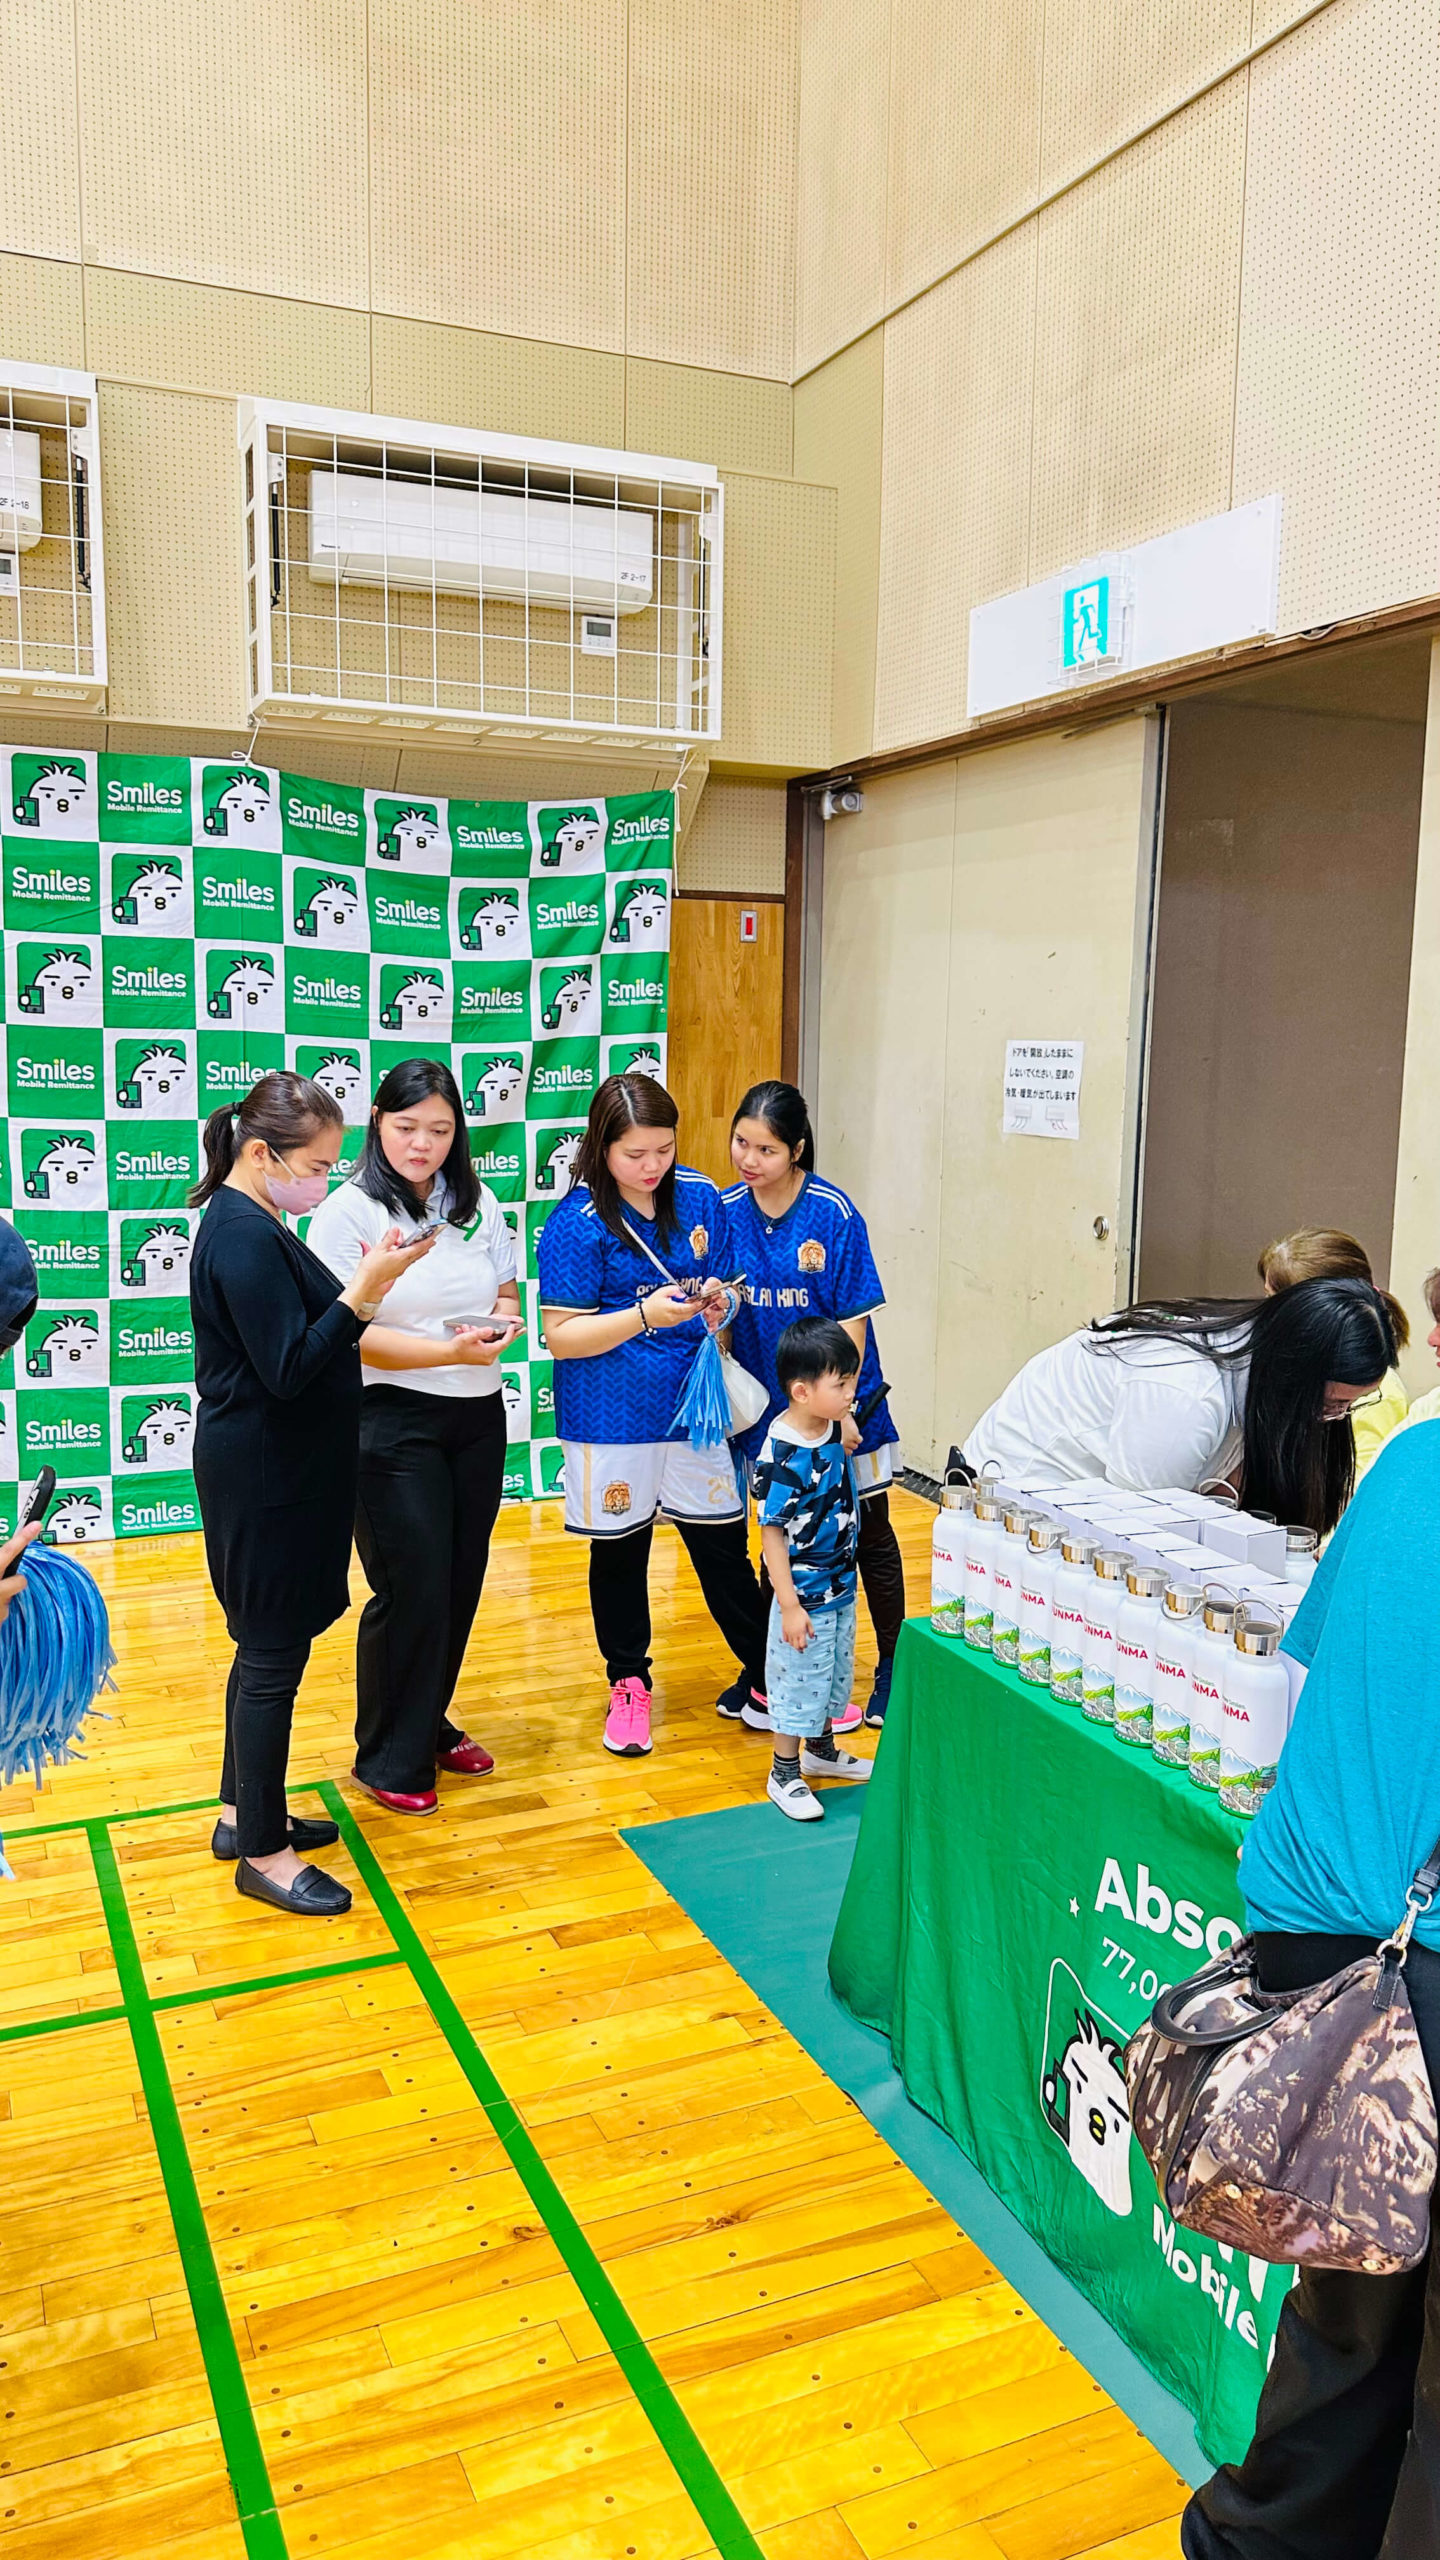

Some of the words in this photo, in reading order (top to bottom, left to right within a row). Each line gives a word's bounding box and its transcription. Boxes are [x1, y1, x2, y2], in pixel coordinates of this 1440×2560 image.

[108, 780, 182, 805] Smiles
[107, 803, 134, 812] Mobile
[137, 805, 182, 814] Remittance
[288, 798, 358, 828] Smiles
[288, 819, 312, 830] Mobile
[314, 822, 358, 836] Remittance
[457, 826, 523, 844] Smiles
[613, 816, 669, 835] Smiles
[12, 867, 90, 893] Smiles
[203, 877, 274, 902] Smiles
[12, 891, 41, 899] Mobile
[44, 893, 90, 902] Remittance
[203, 900, 230, 908] Mobile
[232, 901, 274, 911] Remittance
[375, 897, 440, 922] Smiles
[537, 902, 598, 922] Smiles
[376, 918, 399, 926] Mobile
[401, 920, 441, 930] Remittance
[538, 921, 561, 930] Mobile
[563, 920, 599, 928] Remittance
[112, 966, 186, 988] Smiles
[293, 976, 361, 1001] Smiles
[461, 987, 522, 1006] Smiles
[608, 980, 663, 998] Smiles
[293, 997, 318, 1005] Mobile
[319, 999, 361, 1009] Remittance
[460, 1006, 482, 1014] Mobile
[17, 1058, 95, 1081] Smiles
[533, 1066, 592, 1085] Smiles
[17, 1080, 46, 1088] Mobile
[48, 1081, 95, 1089] Remittance
[206, 1082, 232, 1090] Mobile
[532, 1085, 555, 1093] Mobile
[116, 1151, 190, 1172] Smiles
[471, 1150, 520, 1171] miles
[116, 1172, 144, 1180] Mobile
[146, 1173, 190, 1181] Remittance
[26, 1239, 100, 1260] Smiles
[36, 1261, 50, 1269] bile
[776, 1287, 809, 1308] KING
[119, 1328, 192, 1349] Smiles
[149, 1348, 192, 1356] Remittance
[26, 1419, 101, 1441] Smiles
[27, 1442, 54, 1450] Mobile
[56, 1441, 101, 1449] Remittance
[122, 1502, 194, 1526] Smiles
[1052, 1607, 1084, 1623] UNMA
[1084, 1624, 1113, 1640] UNMA
[1116, 1643, 1149, 1660] UNMA
[1094, 1857, 1244, 1958] Abso
[1153, 2203, 1259, 2349] Mobile
